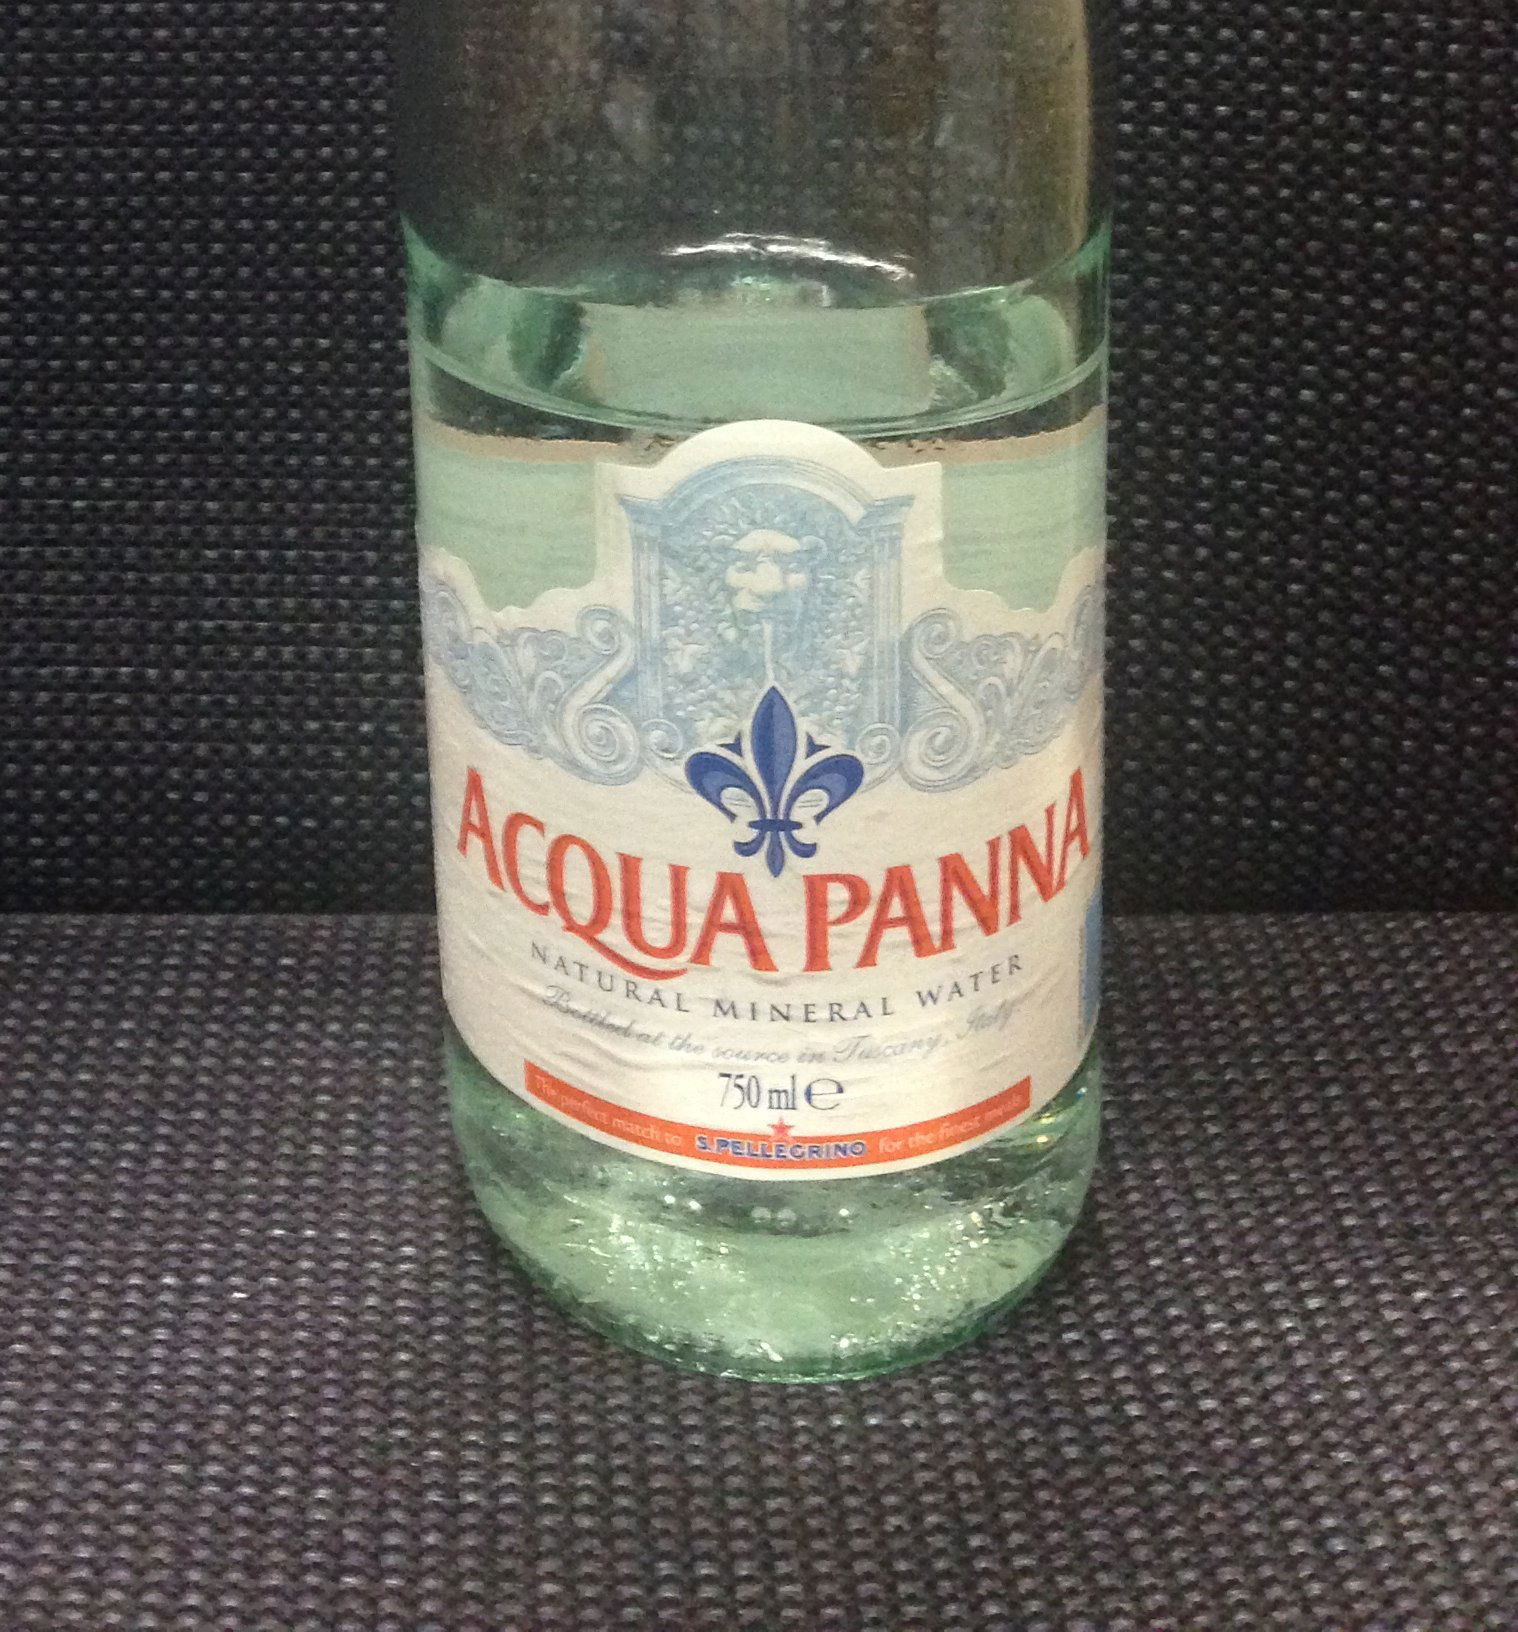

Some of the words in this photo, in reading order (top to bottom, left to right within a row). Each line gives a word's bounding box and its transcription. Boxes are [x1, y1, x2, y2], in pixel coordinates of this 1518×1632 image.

[456, 766, 779, 980] ACQUA
[803, 768, 1091, 972] PANNA
[531, 941, 690, 1013] NATURAL
[713, 996, 896, 1023] MINERAL
[916, 954, 1023, 1008] WATER
[669, 1032, 704, 1054] the
[712, 1044, 790, 1063] source
[796, 1048, 827, 1064] in
[717, 1072, 762, 1110] 750
[767, 1074, 797, 1110] ml
[612, 1117, 658, 1141] match
[878, 1136, 905, 1154] for
[908, 1128, 934, 1149] the
